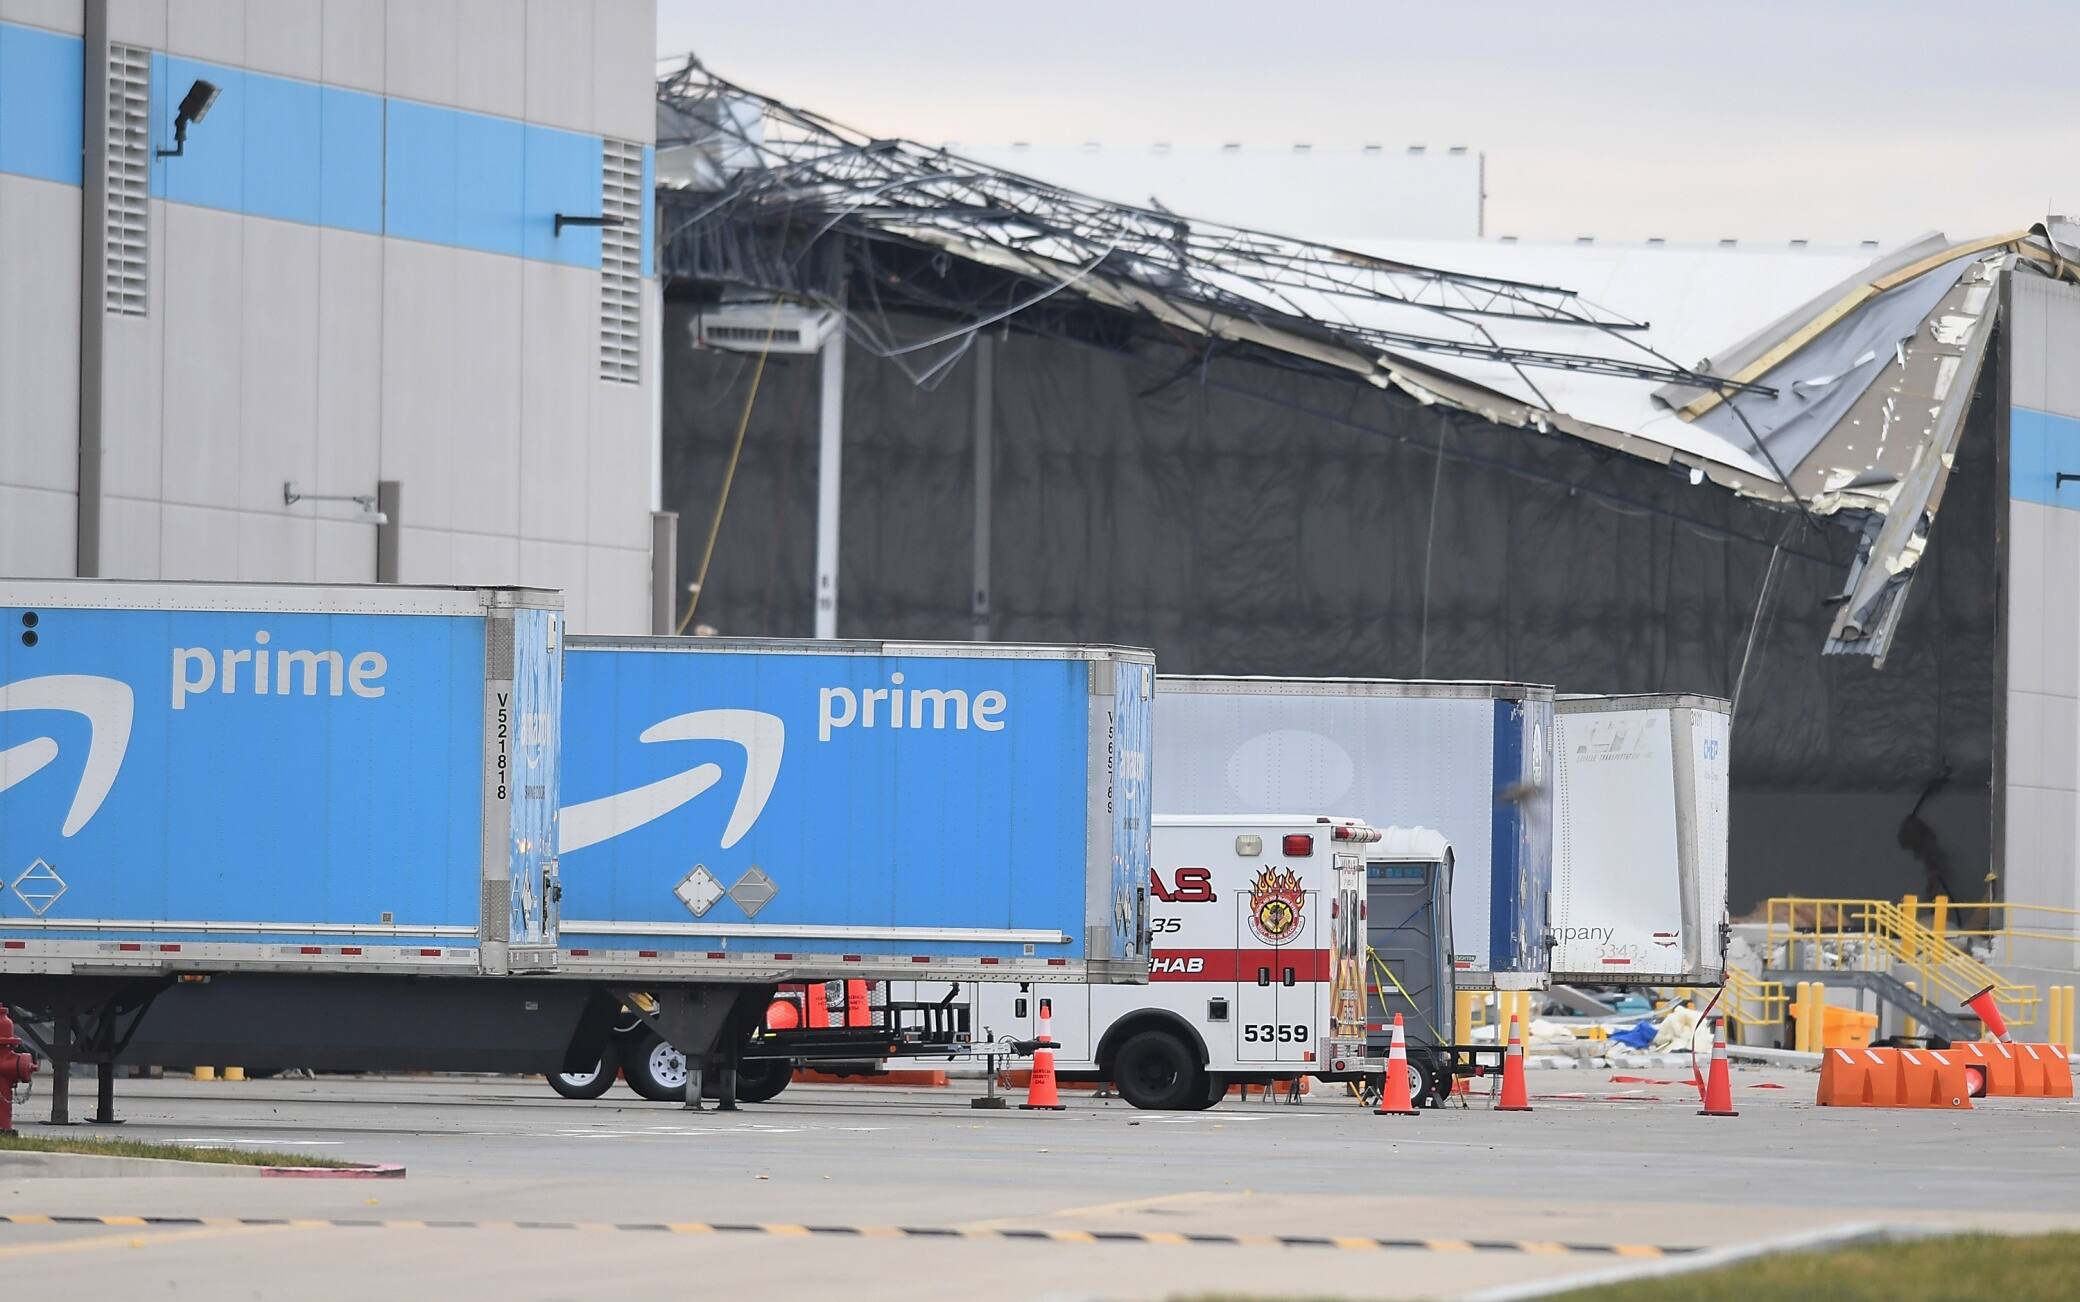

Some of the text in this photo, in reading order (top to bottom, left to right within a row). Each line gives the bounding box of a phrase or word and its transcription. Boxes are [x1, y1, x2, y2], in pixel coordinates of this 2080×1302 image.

[172, 630, 388, 710] prime
[818, 672, 1008, 742] prime
[497, 693, 508, 799] V521818
[1245, 1024, 1309, 1043] 5359
